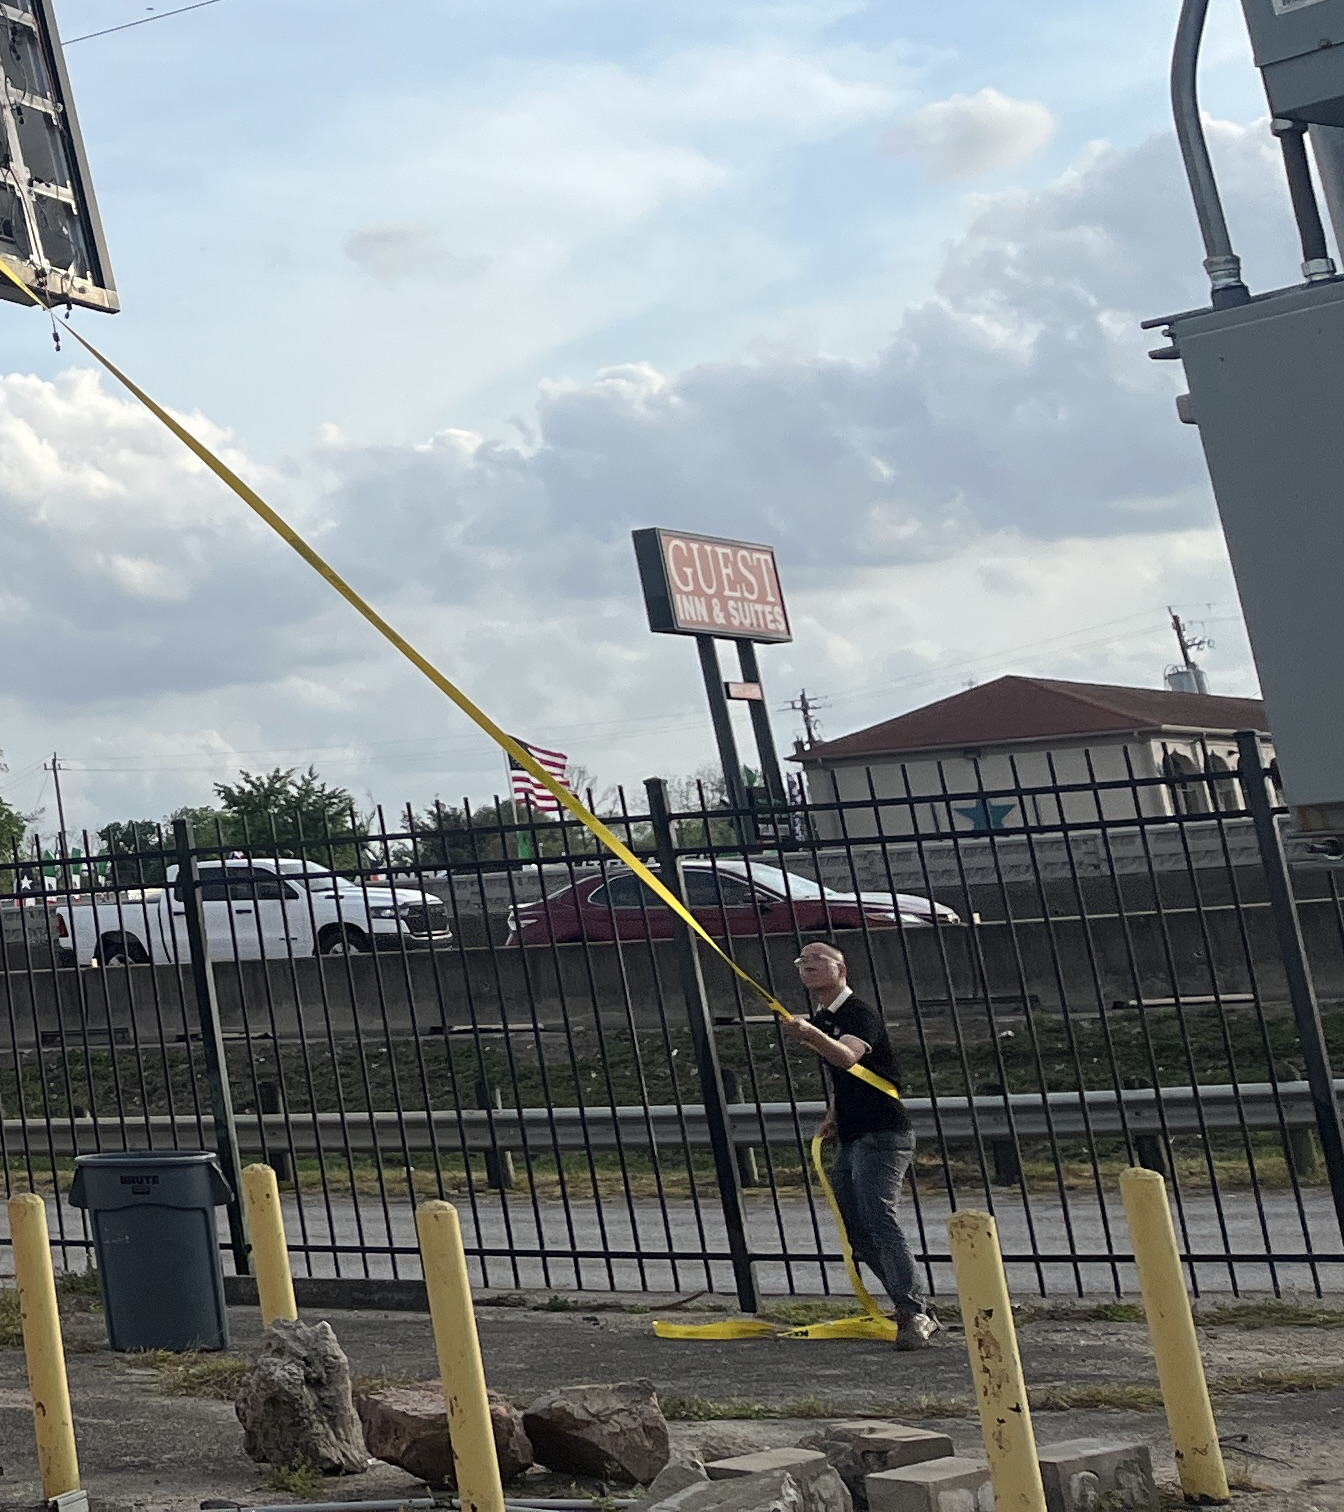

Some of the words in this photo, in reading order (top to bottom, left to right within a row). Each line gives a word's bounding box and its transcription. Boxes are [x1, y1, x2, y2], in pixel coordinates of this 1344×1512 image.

[667, 539, 777, 602] GUEST
[675, 594, 709, 623] INN
[712, 598, 727, 625] &
[727, 600, 786, 632] SUITES
[120, 1175, 160, 1185] BRUTE
